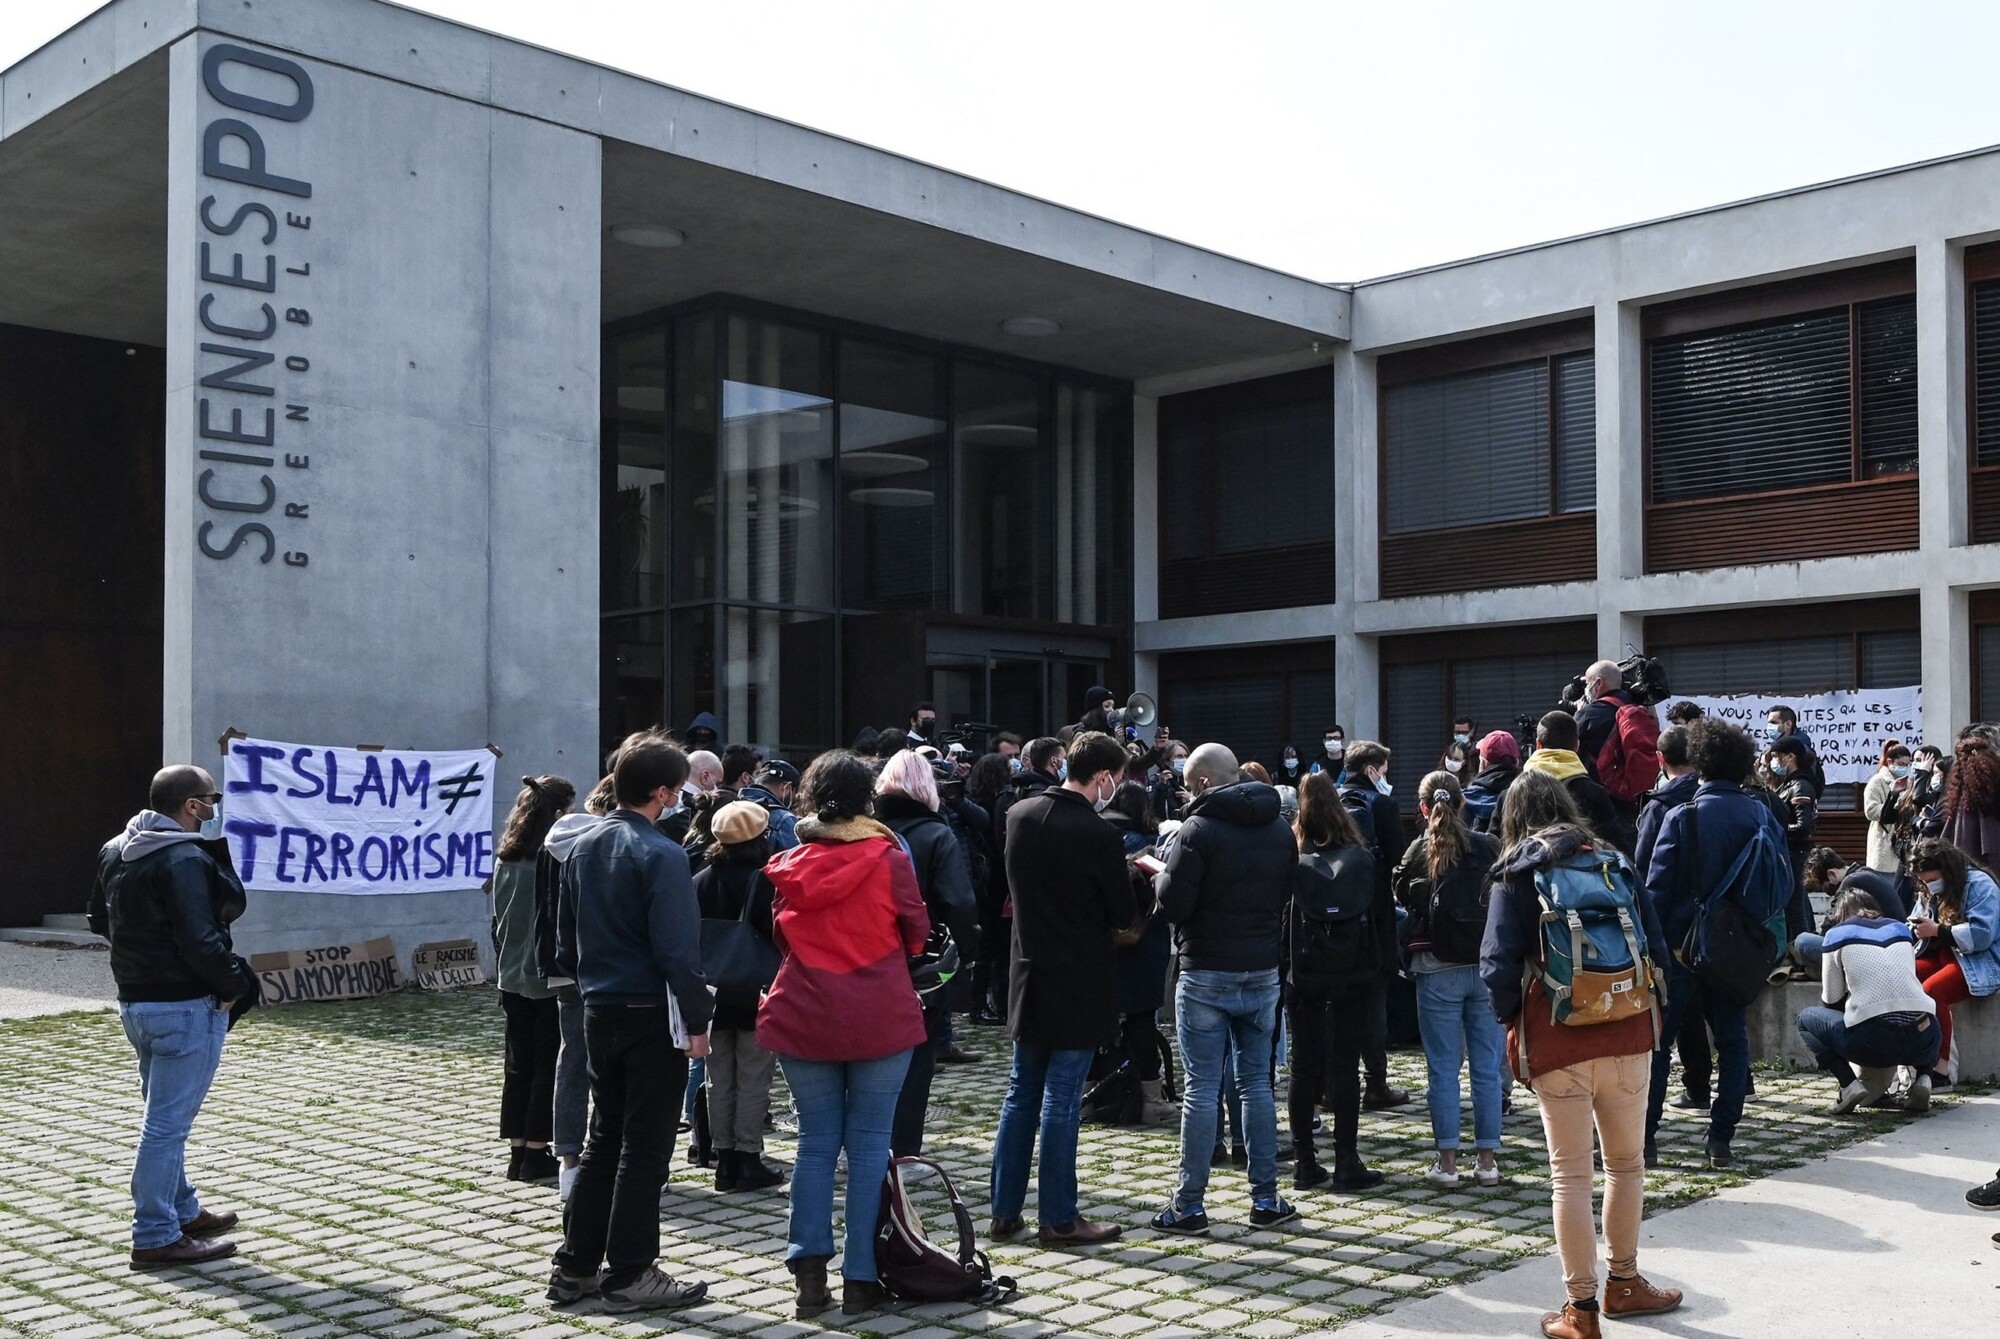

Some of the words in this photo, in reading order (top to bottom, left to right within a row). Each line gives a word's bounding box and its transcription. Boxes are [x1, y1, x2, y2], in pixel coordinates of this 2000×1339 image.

[284, 211, 311, 567] GRENOBLE
[1718, 707, 1753, 719] VOUS
[1865, 704, 1892, 714] LES
[1798, 722, 1857, 734] ROMPENT
[1863, 722, 1880, 732] ET
[1884, 720, 1914, 732] QUE
[227, 745, 430, 810] ISLAM
[305, 946, 351, 963] STOP
[416, 952, 428, 964] LE
[436, 948, 476, 962] RACISME
[434, 962, 450, 970] EST
[419, 971, 439, 986] UN
